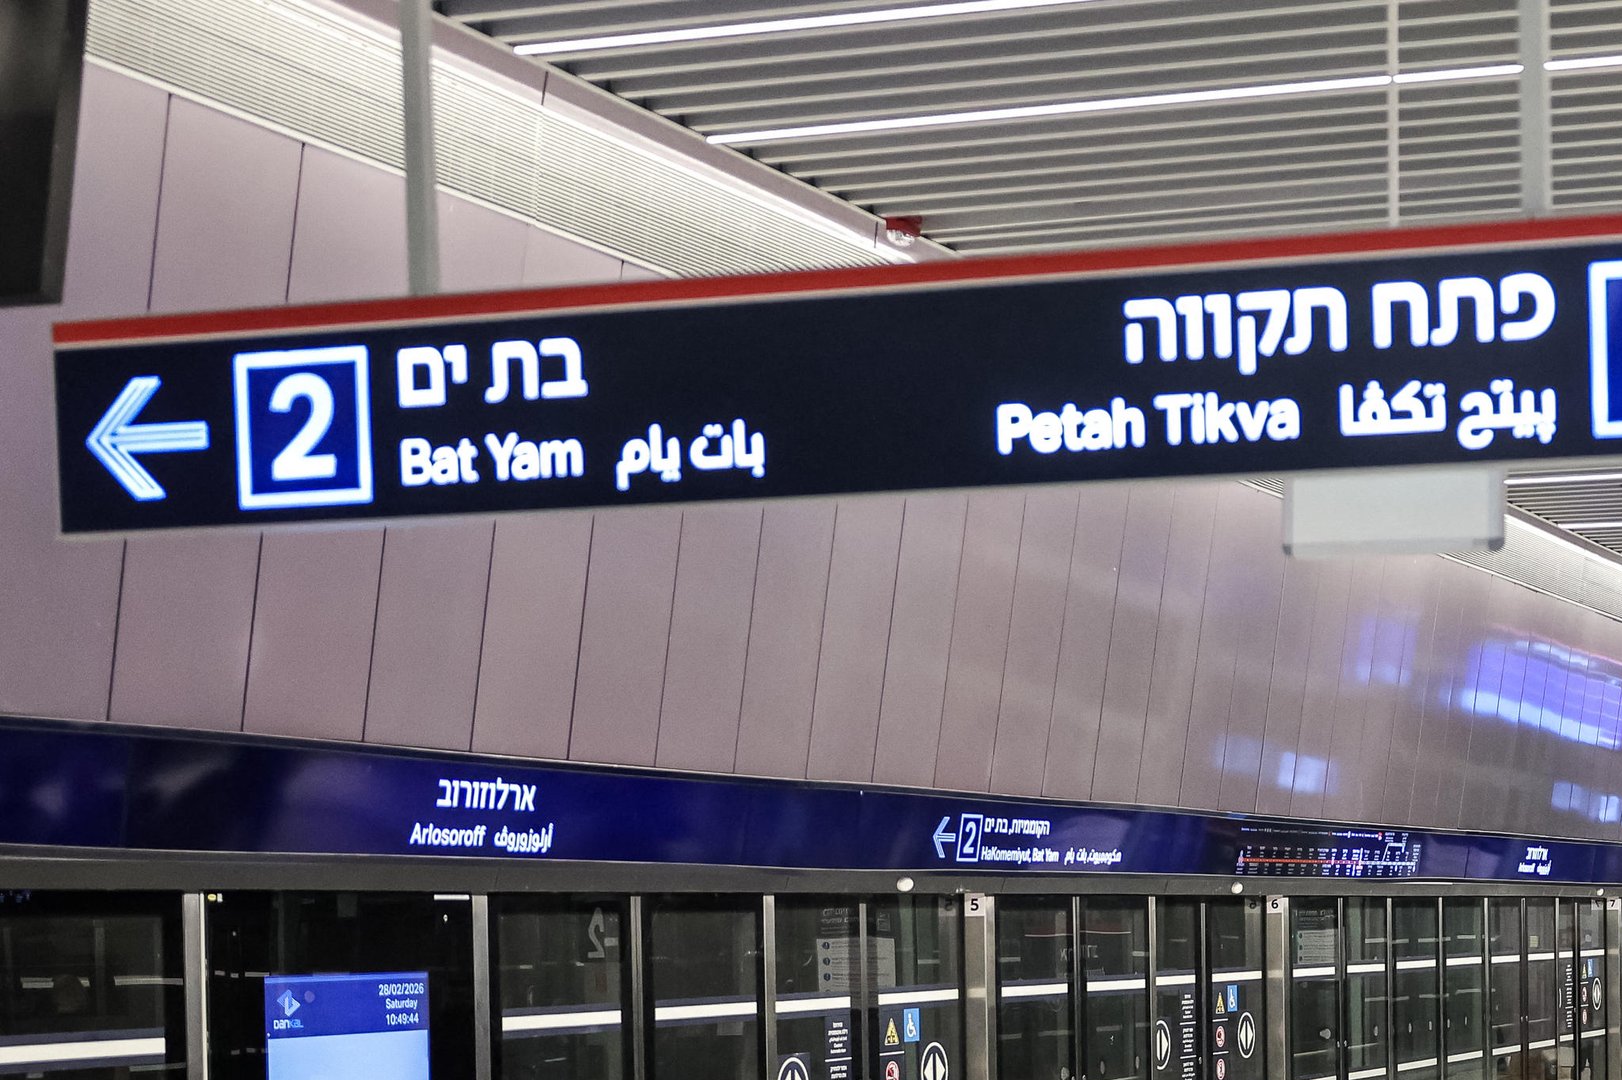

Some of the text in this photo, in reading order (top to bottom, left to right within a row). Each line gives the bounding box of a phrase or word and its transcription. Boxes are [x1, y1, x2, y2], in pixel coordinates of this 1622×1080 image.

[1124, 272, 1557, 376] פתח תקווה
[398, 337, 588, 407] בת ים
[271, 373, 336, 481] 2
[997, 393, 1299, 455] Petah Tikva
[401, 433, 584, 486] Bat Yam
[616, 418, 765, 491] بات يام
[436, 777, 537, 811] ארלוזורוב
[409, 822, 487, 847] Arlosoroff
[984, 817, 995, 832] ים
[994, 818, 1008, 833] בת
[963, 821, 977, 854] 2
[1032, 848, 1044, 862] Bat
[1045, 848, 1059, 862] Yam
[971, 898, 979, 911] 5
[1271, 899, 1279, 909] 6
[378, 983, 424, 996] 28/02/2026
[385, 998, 418, 1010] Saturday
[385, 1013, 419, 1026] 10:49:44
